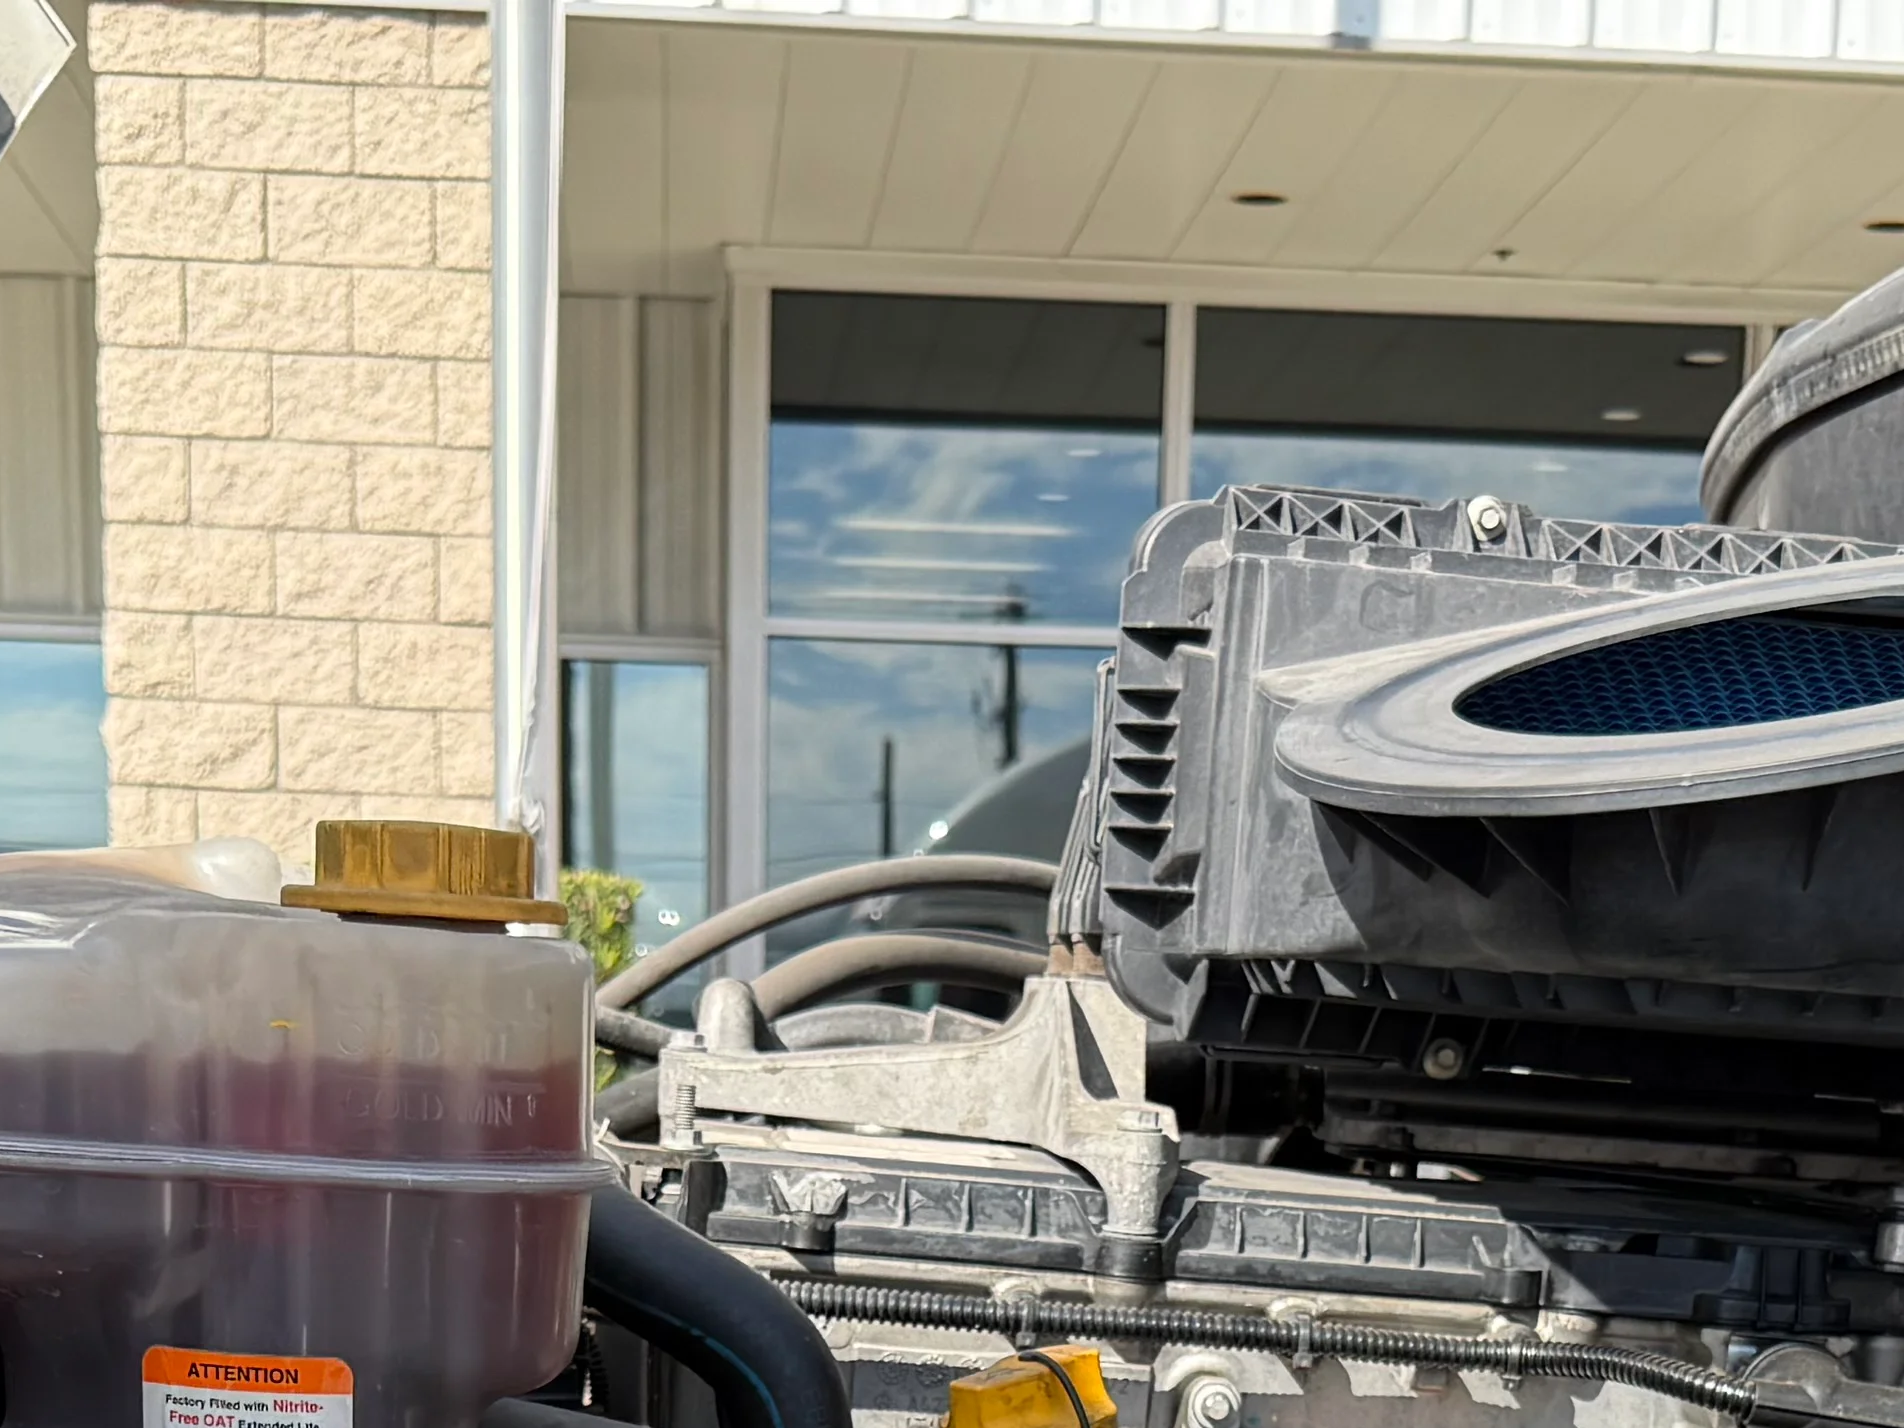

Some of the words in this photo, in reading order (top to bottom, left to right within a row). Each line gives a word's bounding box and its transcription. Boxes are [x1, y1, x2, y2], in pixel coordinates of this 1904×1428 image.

[187, 1362, 299, 1385] ATTENTION
[165, 1394, 206, 1411] Factory
[209, 1398, 241, 1411] Filled
[243, 1401, 269, 1412] with
[273, 1399, 324, 1414] Nitrite-
[169, 1410, 199, 1426] Free
[203, 1414, 235, 1428] OAT
